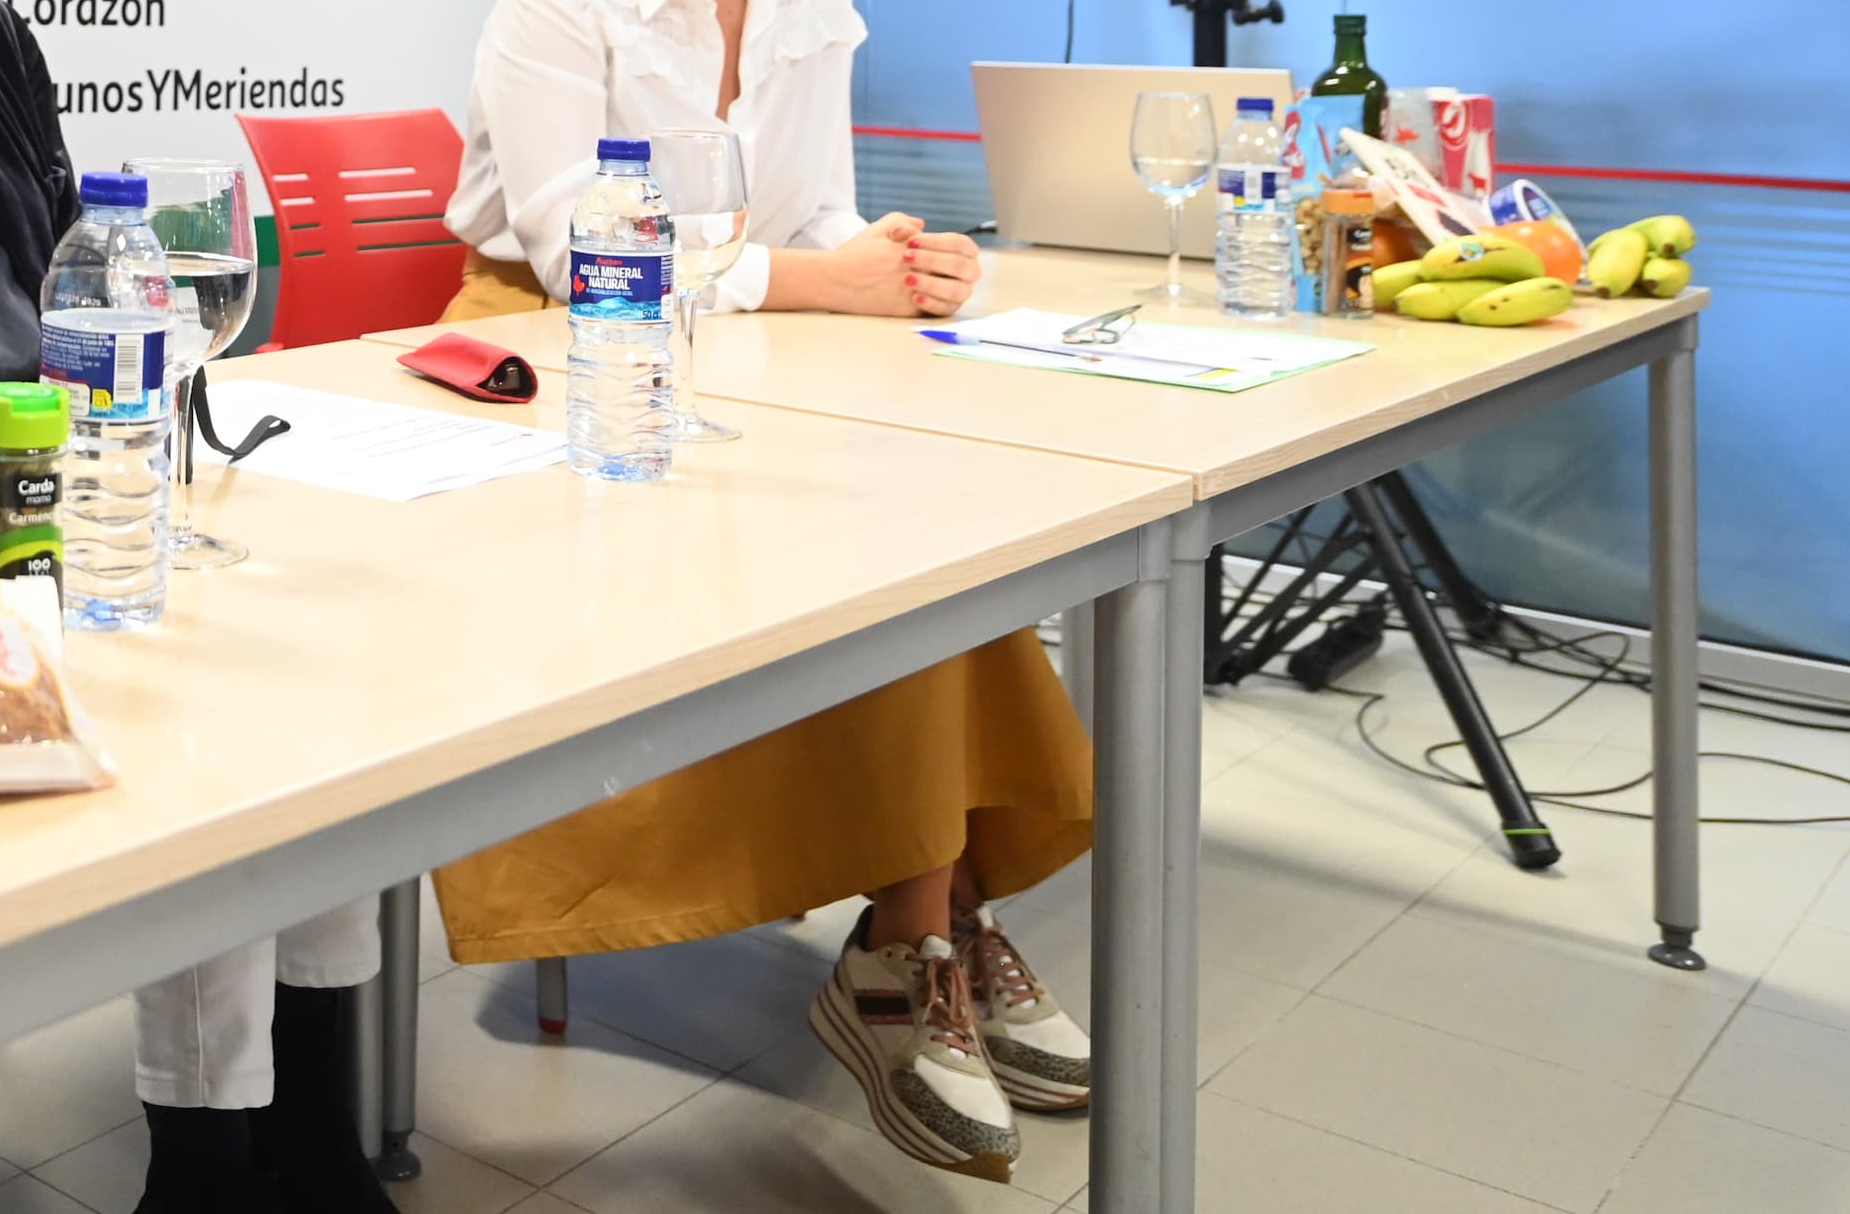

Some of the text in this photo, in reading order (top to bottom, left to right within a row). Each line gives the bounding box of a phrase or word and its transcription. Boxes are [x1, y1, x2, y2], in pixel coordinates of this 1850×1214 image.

[52, 66, 346, 115] unosYMeriendas
[579, 263, 600, 277] AGUA
[600, 265, 644, 280] MINERAL
[588, 276, 631, 291] NATURAL
[18, 478, 56, 495] Carda
[27, 557, 52, 572] 100
